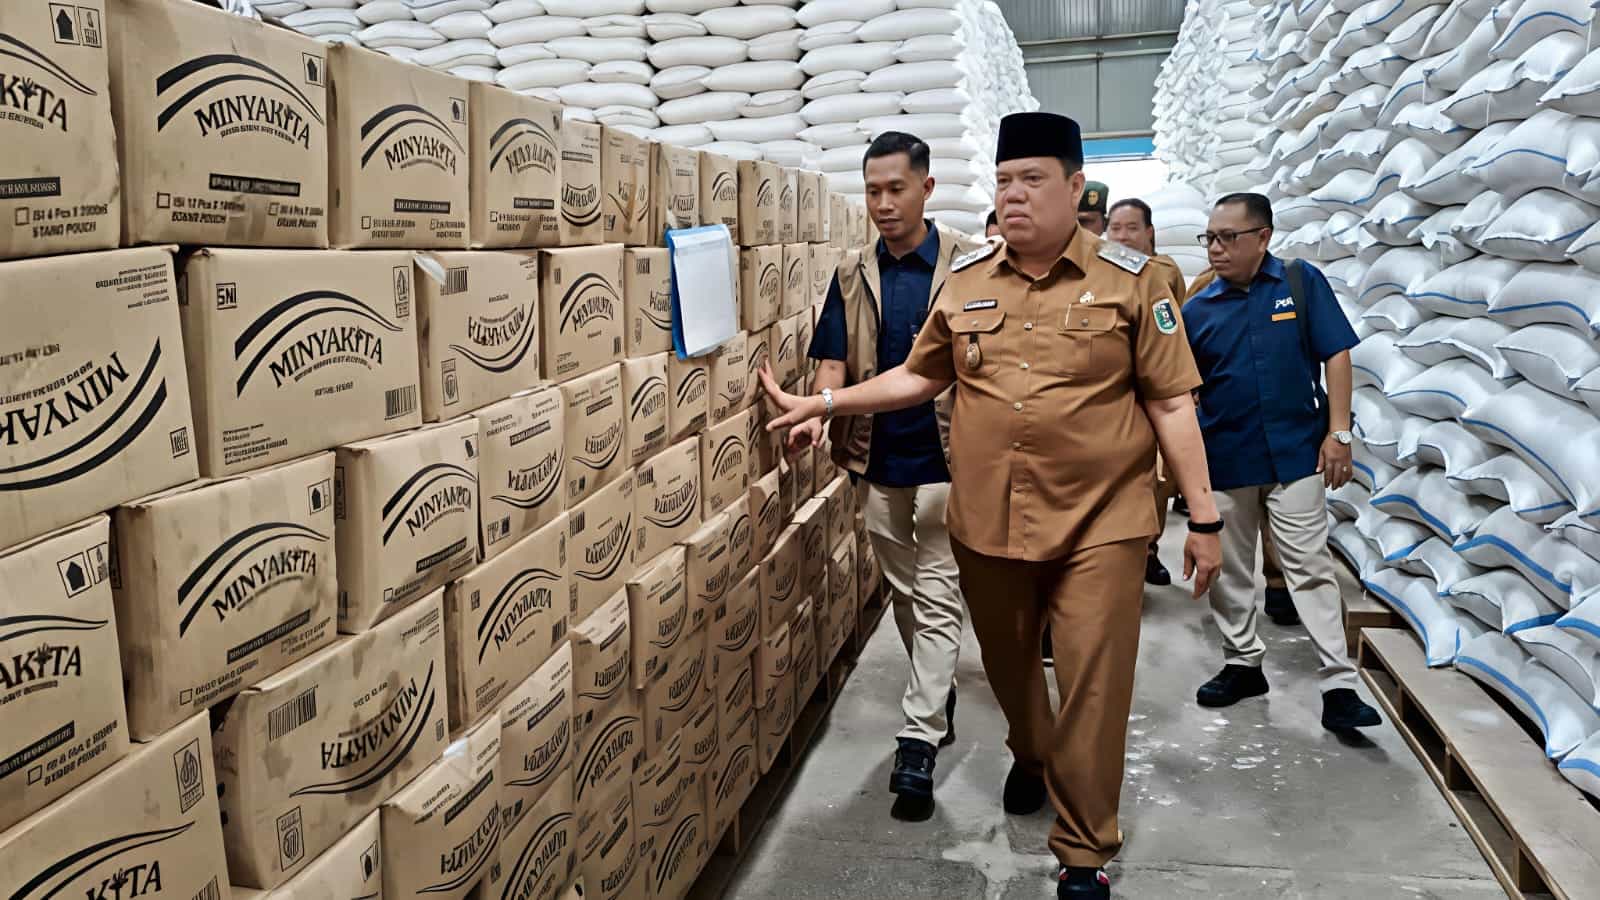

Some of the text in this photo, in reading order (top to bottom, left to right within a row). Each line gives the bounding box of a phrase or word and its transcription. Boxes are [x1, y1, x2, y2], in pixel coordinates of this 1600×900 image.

[194, 95, 309, 149] MINYAKITA
[268, 325, 382, 388] MINYAKITA
[212, 546, 316, 622] MINYAKITA
[321, 677, 418, 769] MINYAKITA
